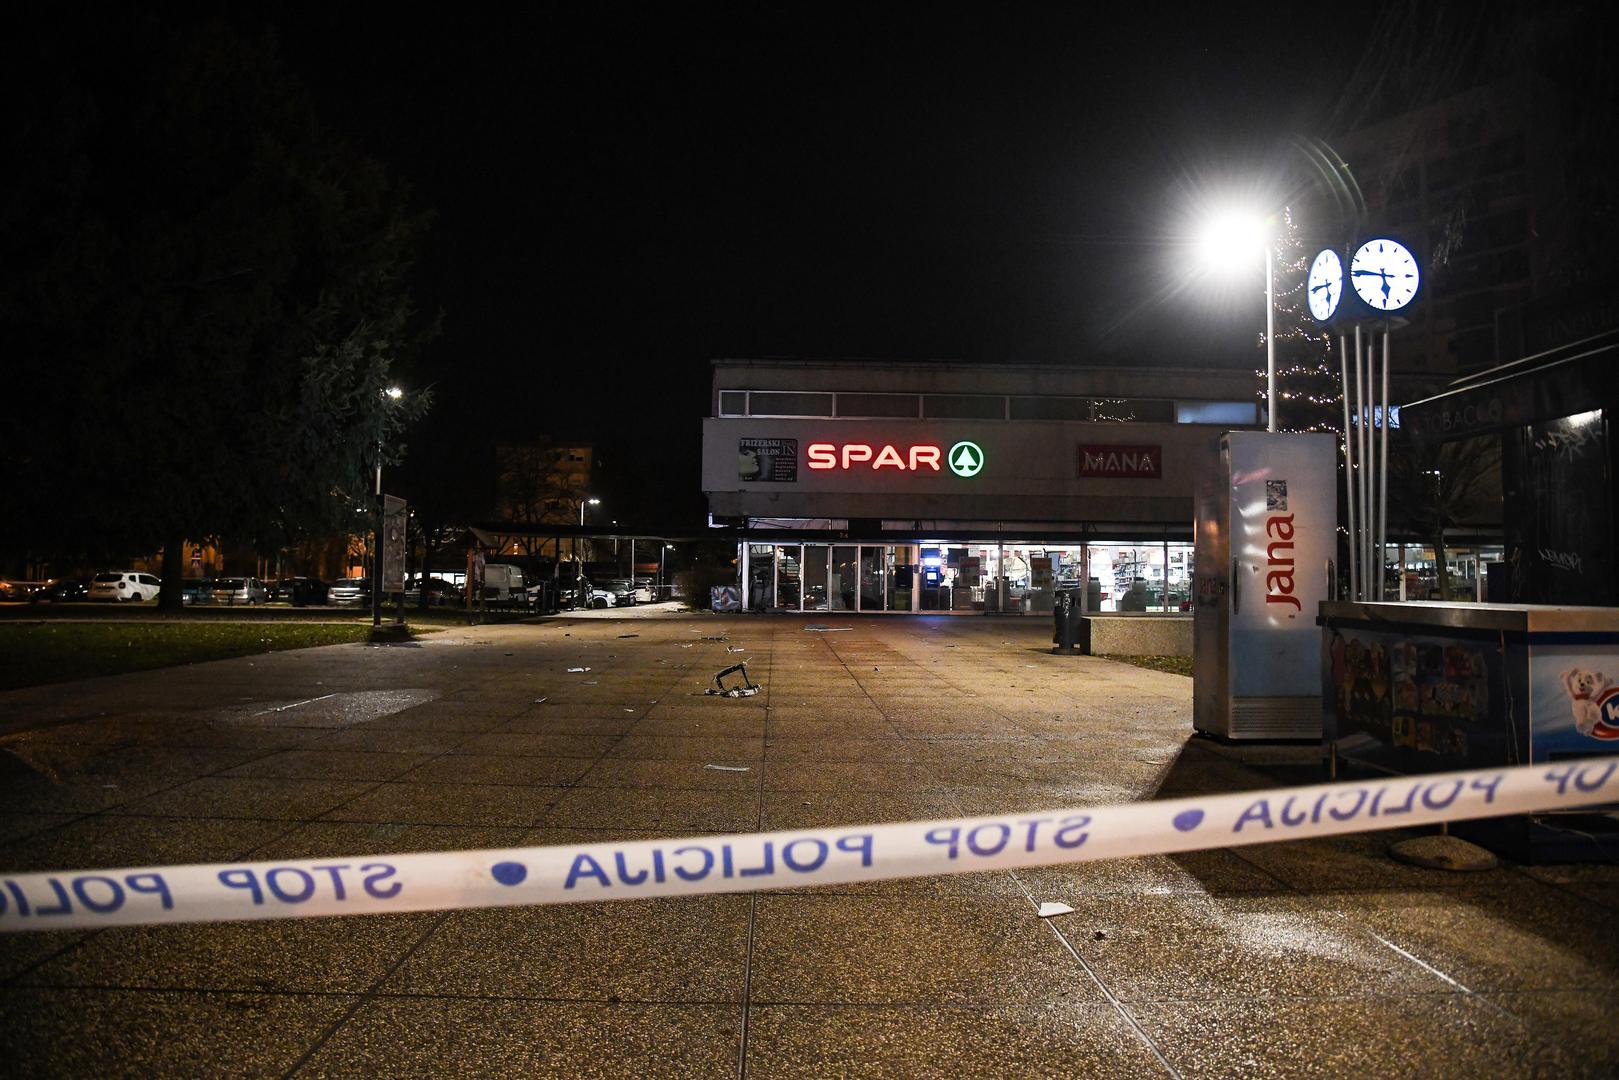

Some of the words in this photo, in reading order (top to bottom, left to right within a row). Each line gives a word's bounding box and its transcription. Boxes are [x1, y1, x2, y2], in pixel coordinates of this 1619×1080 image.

[741, 439, 780, 447] FRIZERSKI
[756, 448, 780, 456] SALON
[807, 443, 942, 471] SPAR
[1083, 451, 1155, 472] MANA
